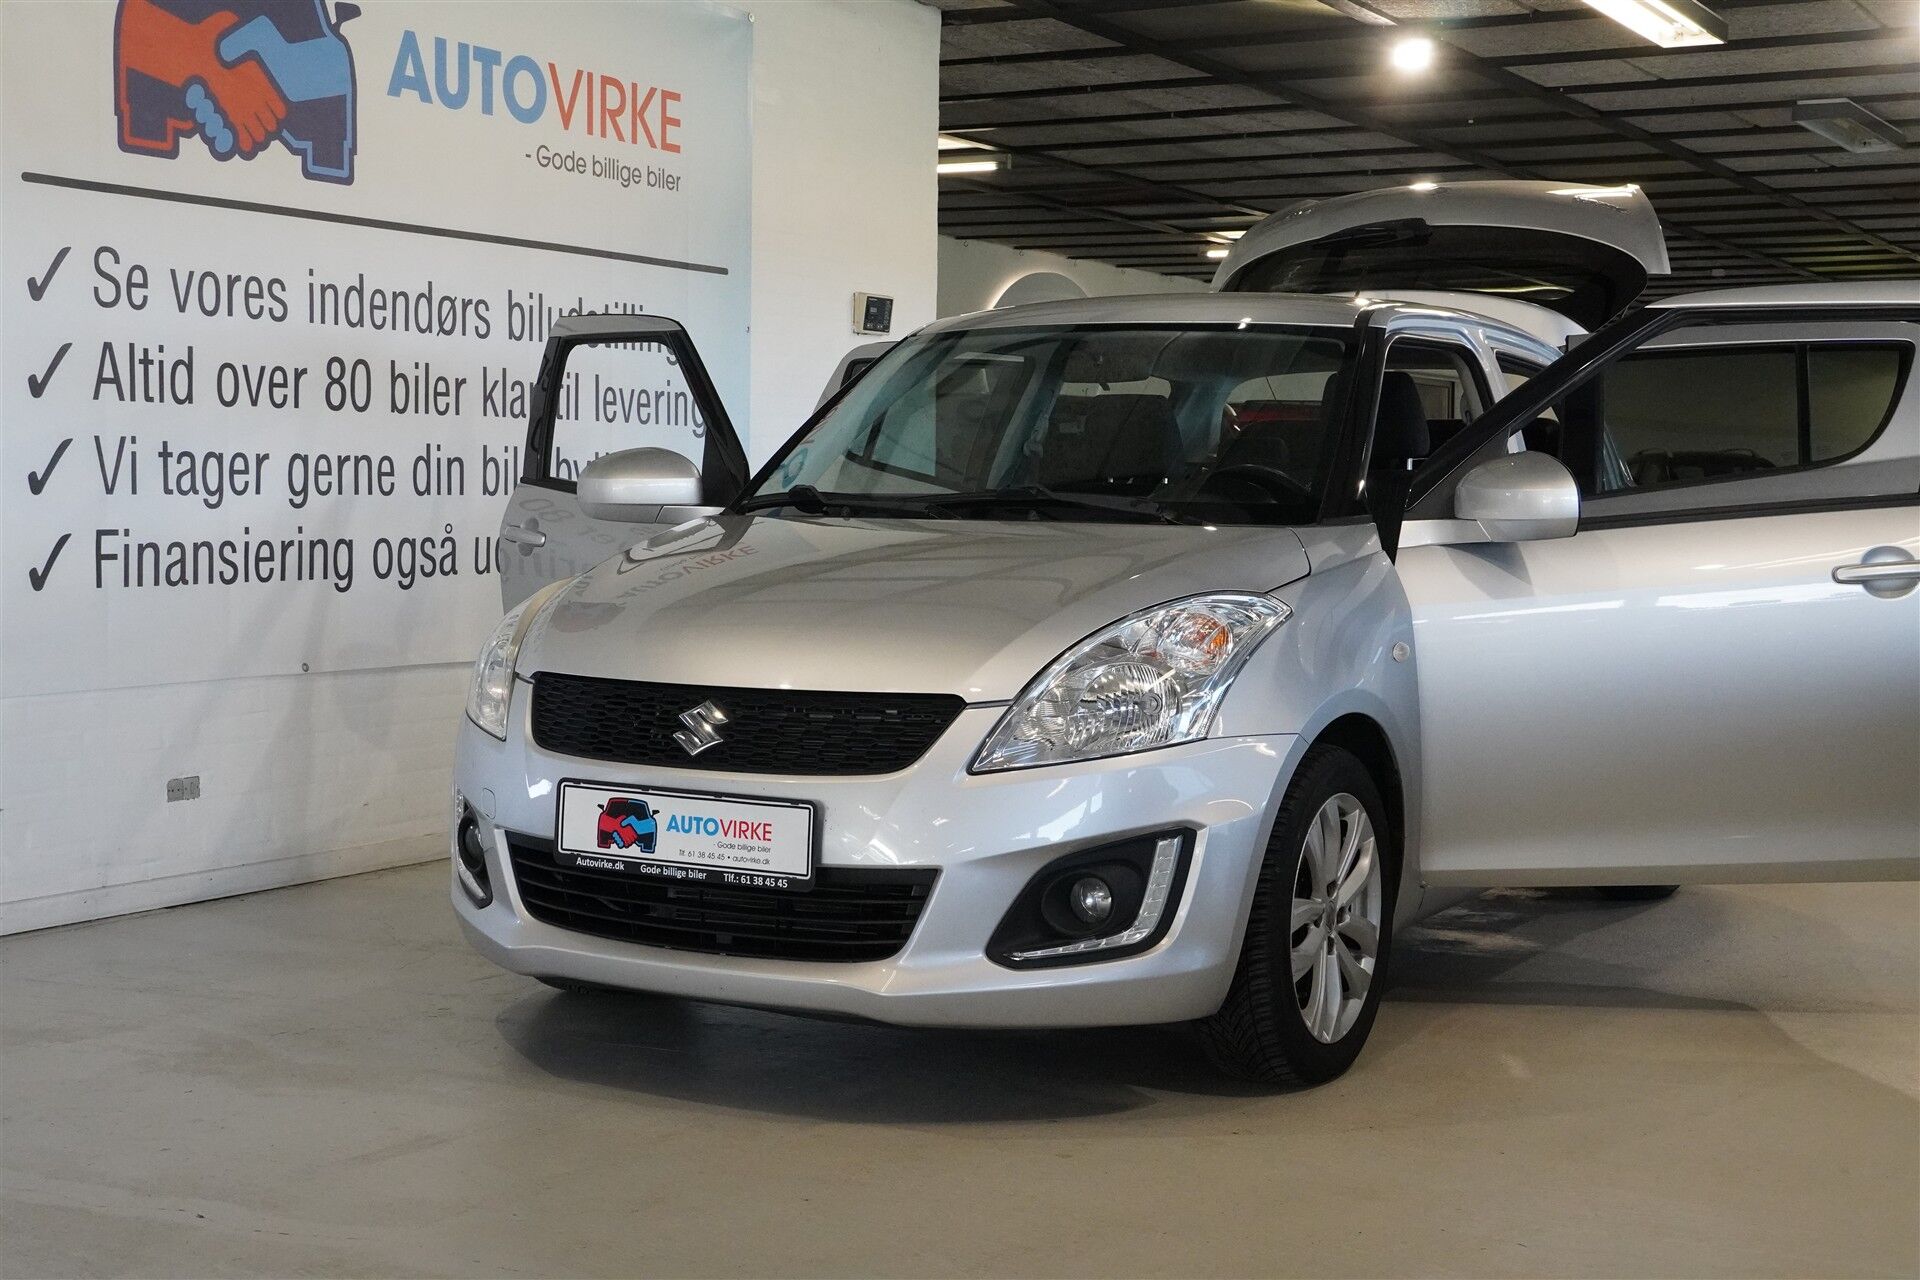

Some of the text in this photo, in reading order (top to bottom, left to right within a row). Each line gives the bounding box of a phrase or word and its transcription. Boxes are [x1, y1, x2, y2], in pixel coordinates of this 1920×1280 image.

[387, 29, 681, 153] AUTOVIRKE
[536, 144, 587, 174] Gode
[592, 155, 642, 188] billige
[647, 165, 681, 191] biler
[94, 246, 148, 310] Se
[170, 269, 288, 322] vores
[309, 268, 490, 339] indendørs
[93, 341, 193, 405] Altid
[217, 360, 307, 408] over
[325, 356, 371, 412] 80
[391, 360, 466, 416] biler
[483, 366, 534, 418] kla
[595, 374, 706, 438] levering
[94, 435, 137, 495] Vi
[158, 441, 269, 509] tager
[288, 453, 394, 506] gerne
[413, 443, 464, 496] din
[483, 445, 518, 496] bil
[95, 526, 354, 593] Finansiering
[373, 523, 458, 590] også
[666, 815, 772, 841] AUTOVIRKE
[687, 850, 695, 858] 61
[697, 851, 706, 859] 38
[707, 852, 716, 860] 45
[717, 853, 726, 861] 45
[717, 841, 736, 850] Gode
[576, 857, 625, 871] Autovirke.dk
[640, 864, 661, 874] Gode
[663, 866, 687, 879] billige
[688, 869, 707, 880] biler
[740, 875, 751, 884] 61
[753, 876, 764, 886] 38
[765, 877, 776, 887] 45
[777, 879, 788, 888] 45
